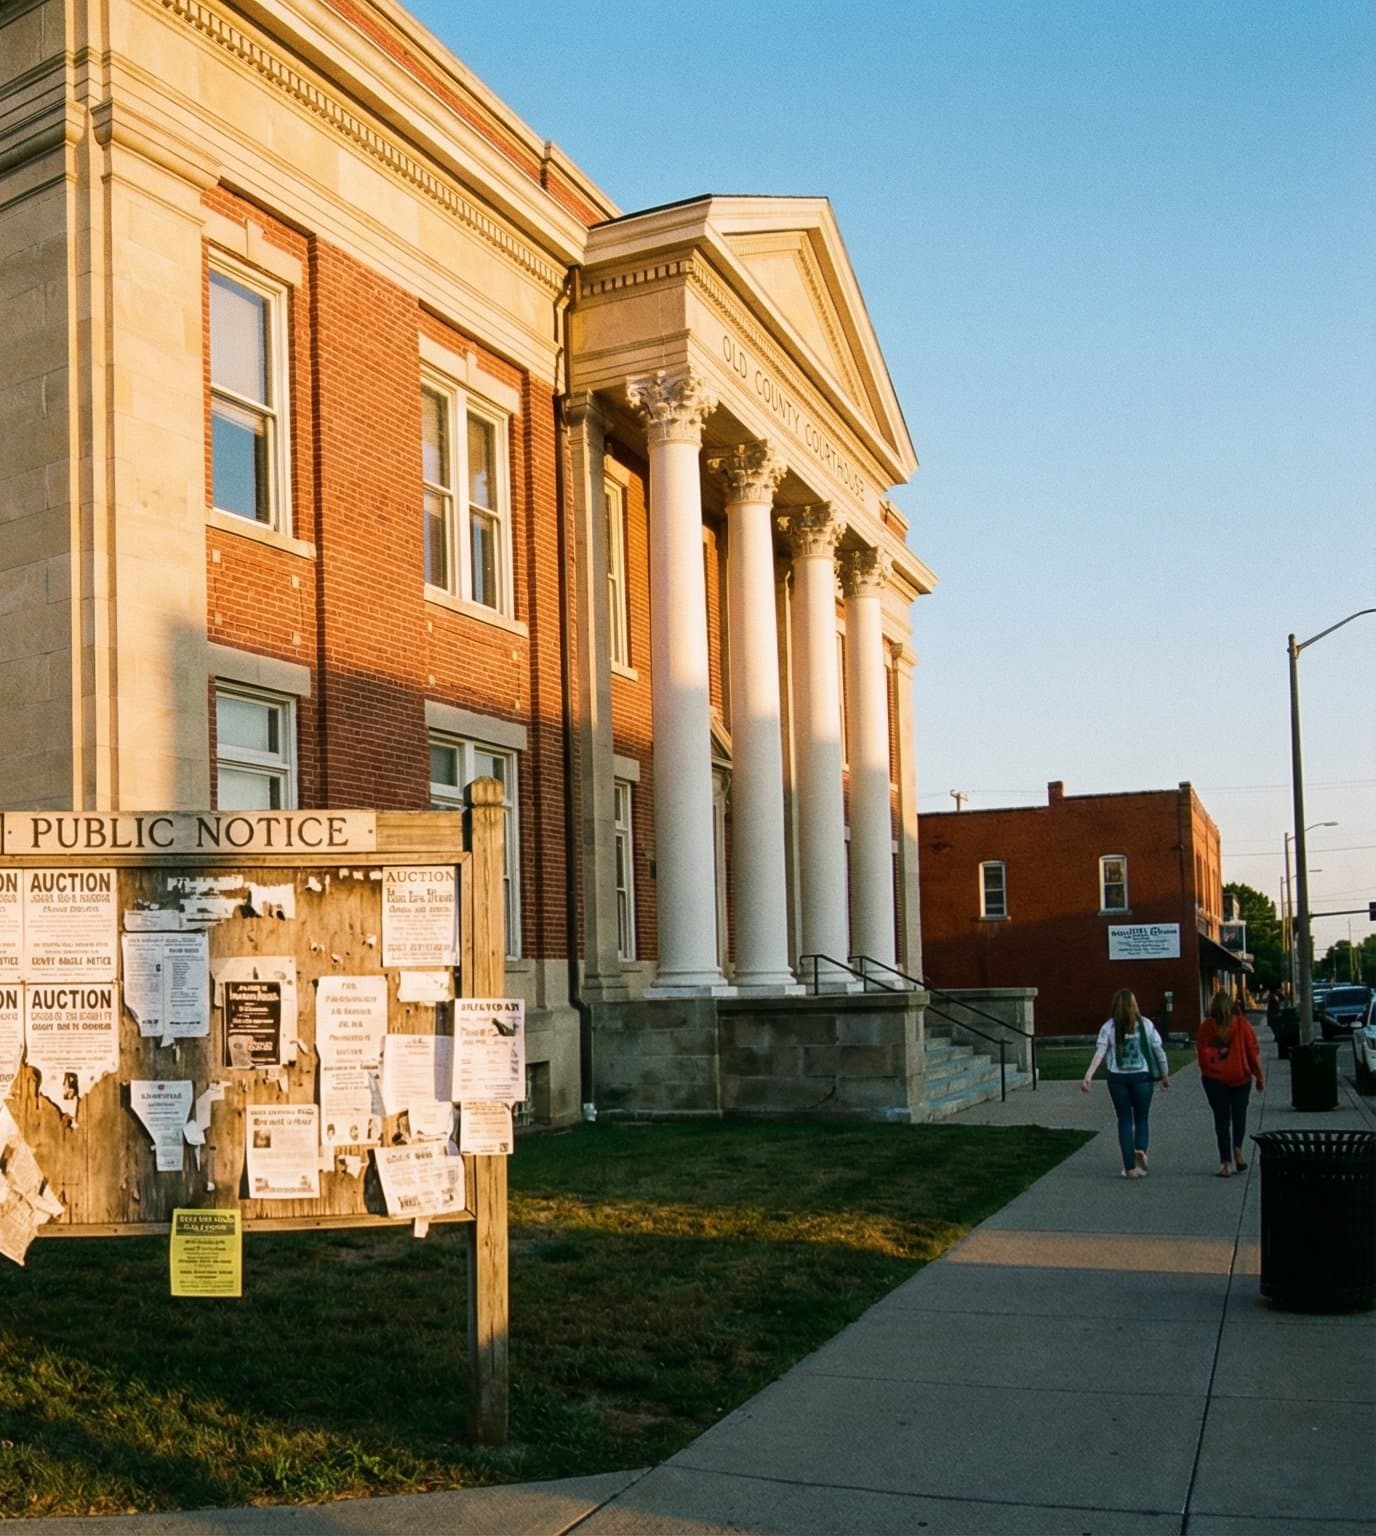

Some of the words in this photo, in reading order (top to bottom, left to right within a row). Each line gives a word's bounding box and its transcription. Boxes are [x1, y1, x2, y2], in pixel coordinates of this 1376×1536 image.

[722, 335, 748, 379] OLD
[755, 370, 800, 433] COUNTY
[805, 423, 865, 502] COURTHOUSE
[31, 817, 174, 848] PUBLIC
[197, 816, 349, 848] NOTICE
[30, 872, 111, 893] AUCTION
[386, 871, 455, 882] AUCTION
[31, 989, 112, 1010] AUCTION
